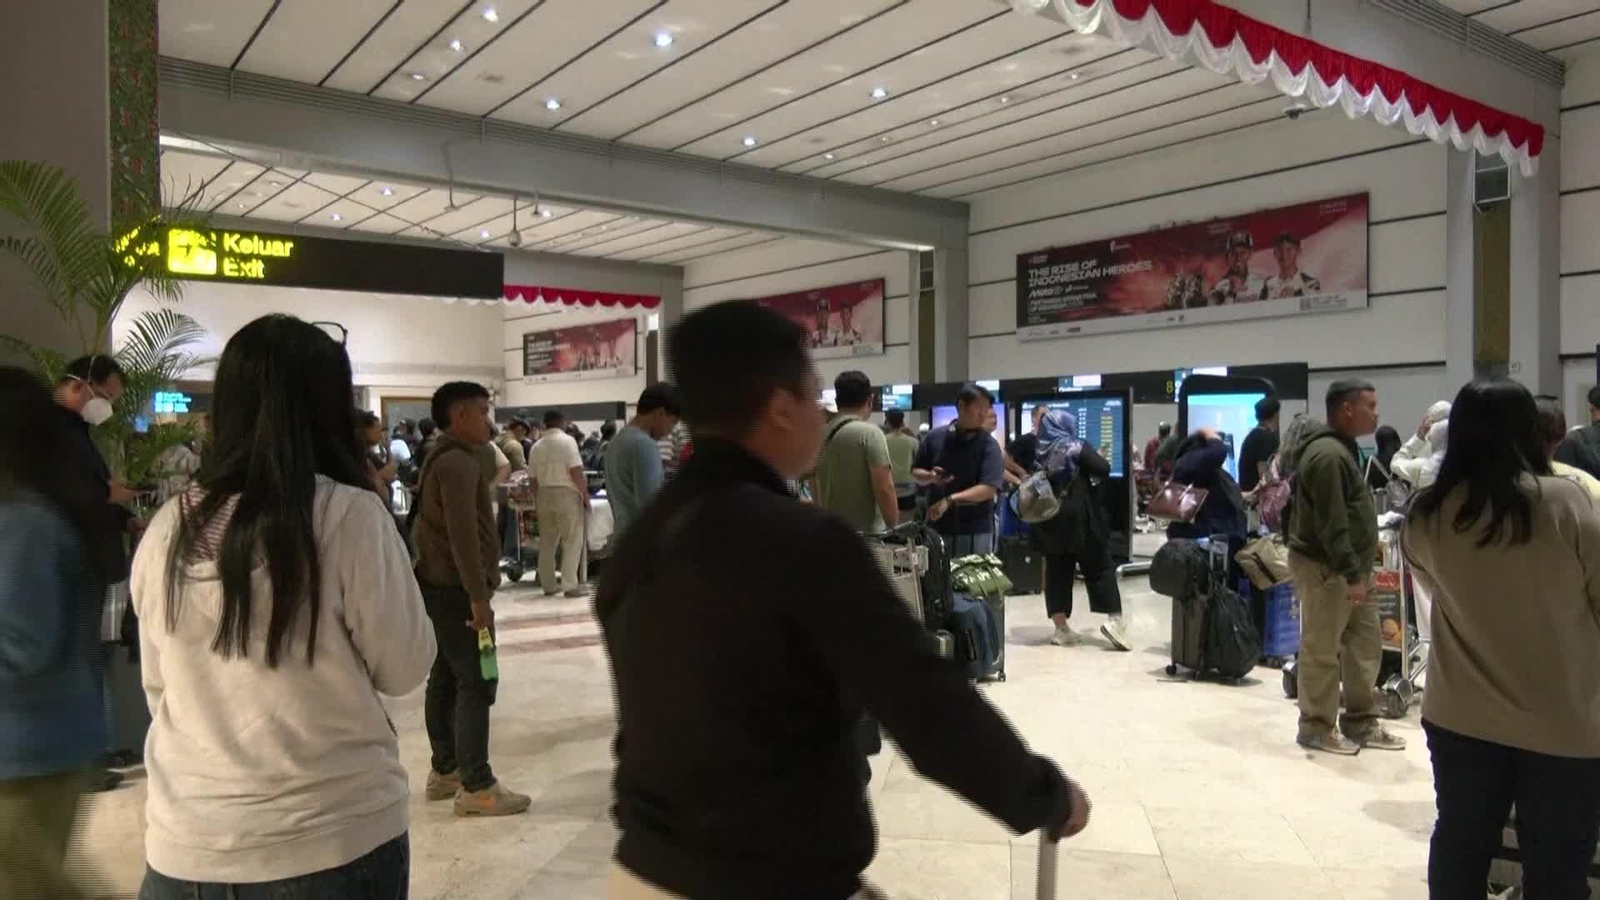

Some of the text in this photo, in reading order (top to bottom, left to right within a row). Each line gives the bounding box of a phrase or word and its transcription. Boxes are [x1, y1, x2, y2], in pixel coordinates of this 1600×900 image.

[223, 232, 293, 257] Keluar
[223, 257, 266, 279] Exit
[1028, 259, 1098, 279] THE RISE OF
[1028, 267, 1101, 288] INDONESIAN
[1103, 260, 1153, 277] HEROES
